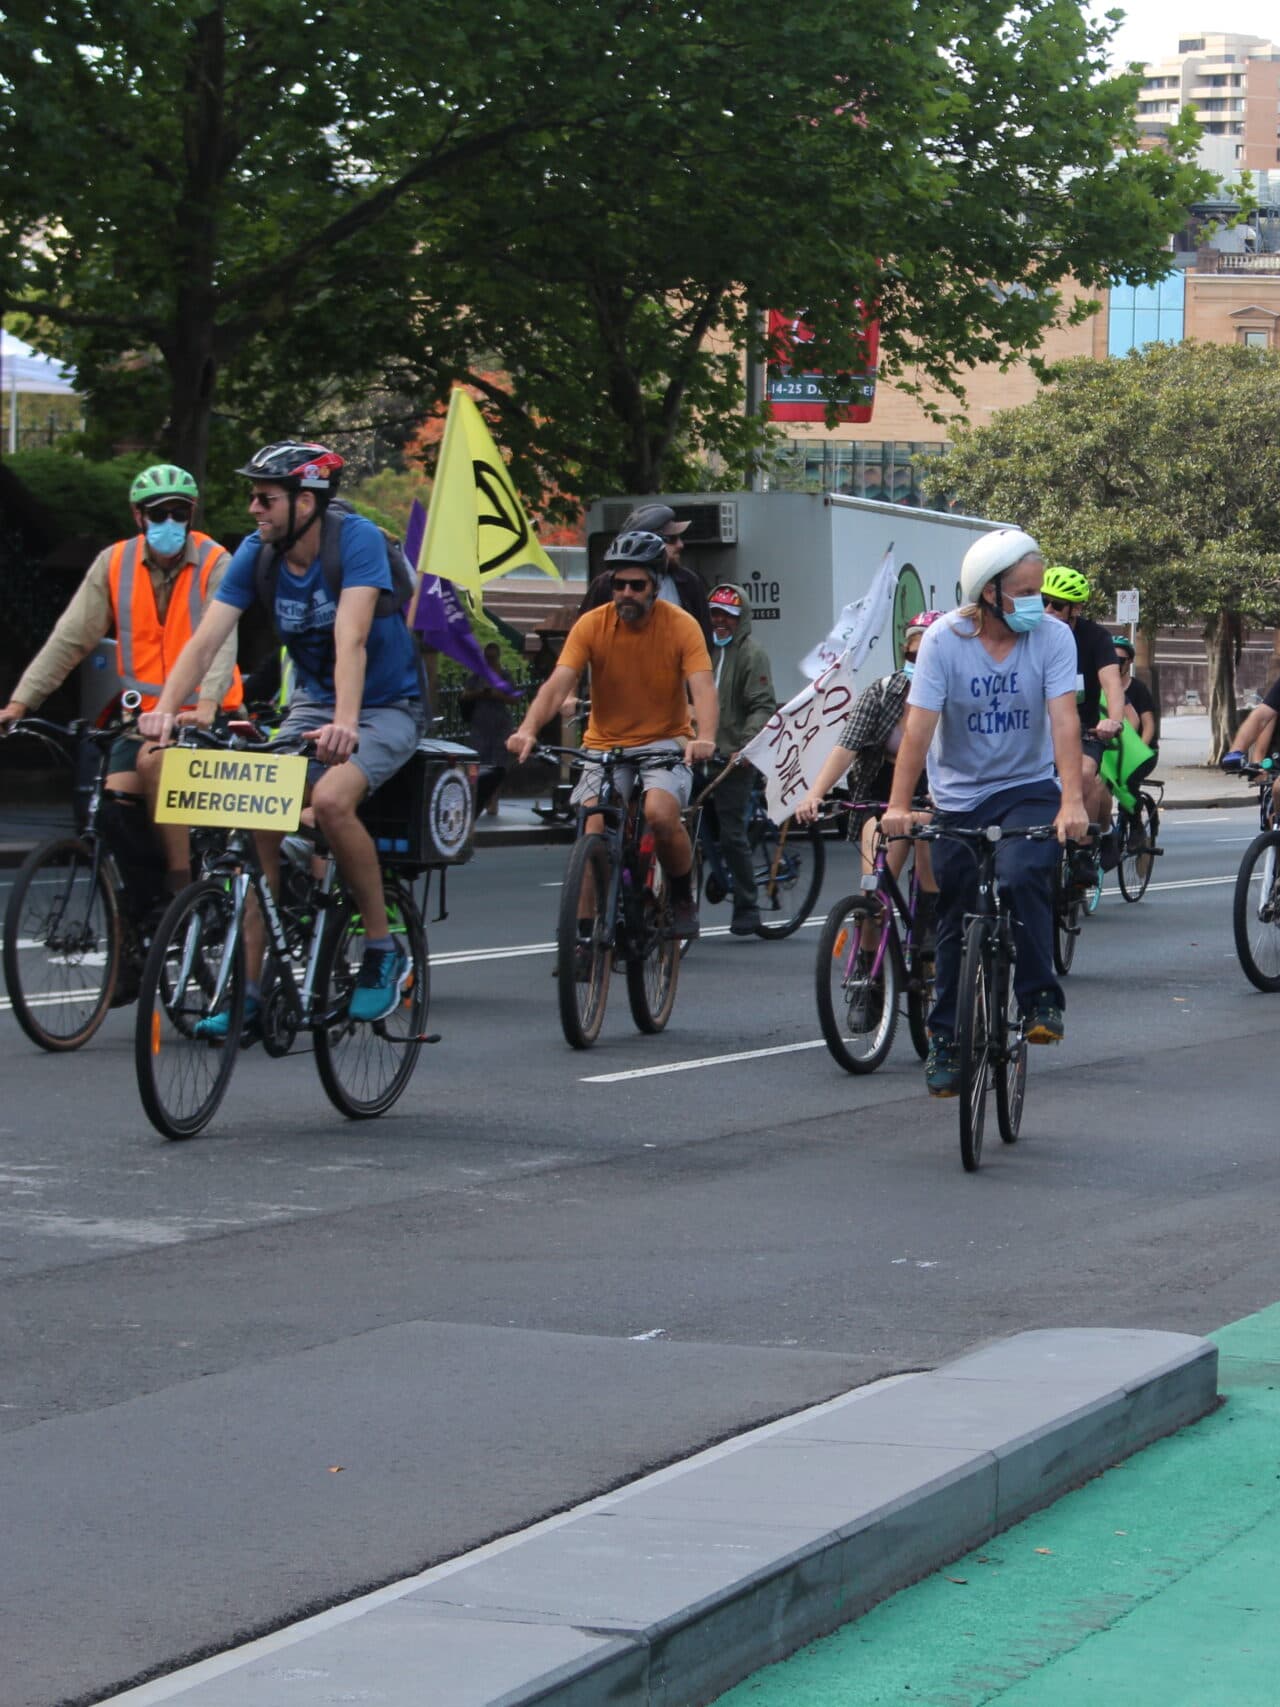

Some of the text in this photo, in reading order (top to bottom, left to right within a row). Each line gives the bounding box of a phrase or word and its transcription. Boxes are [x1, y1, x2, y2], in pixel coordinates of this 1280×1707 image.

[771, 383, 804, 395] 14-25
[970, 672, 1020, 698] CYCLE
[967, 708, 1031, 735] CLIMATE
[188, 760, 279, 784] CLIMATE
[166, 790, 294, 816] EMERGENCY
